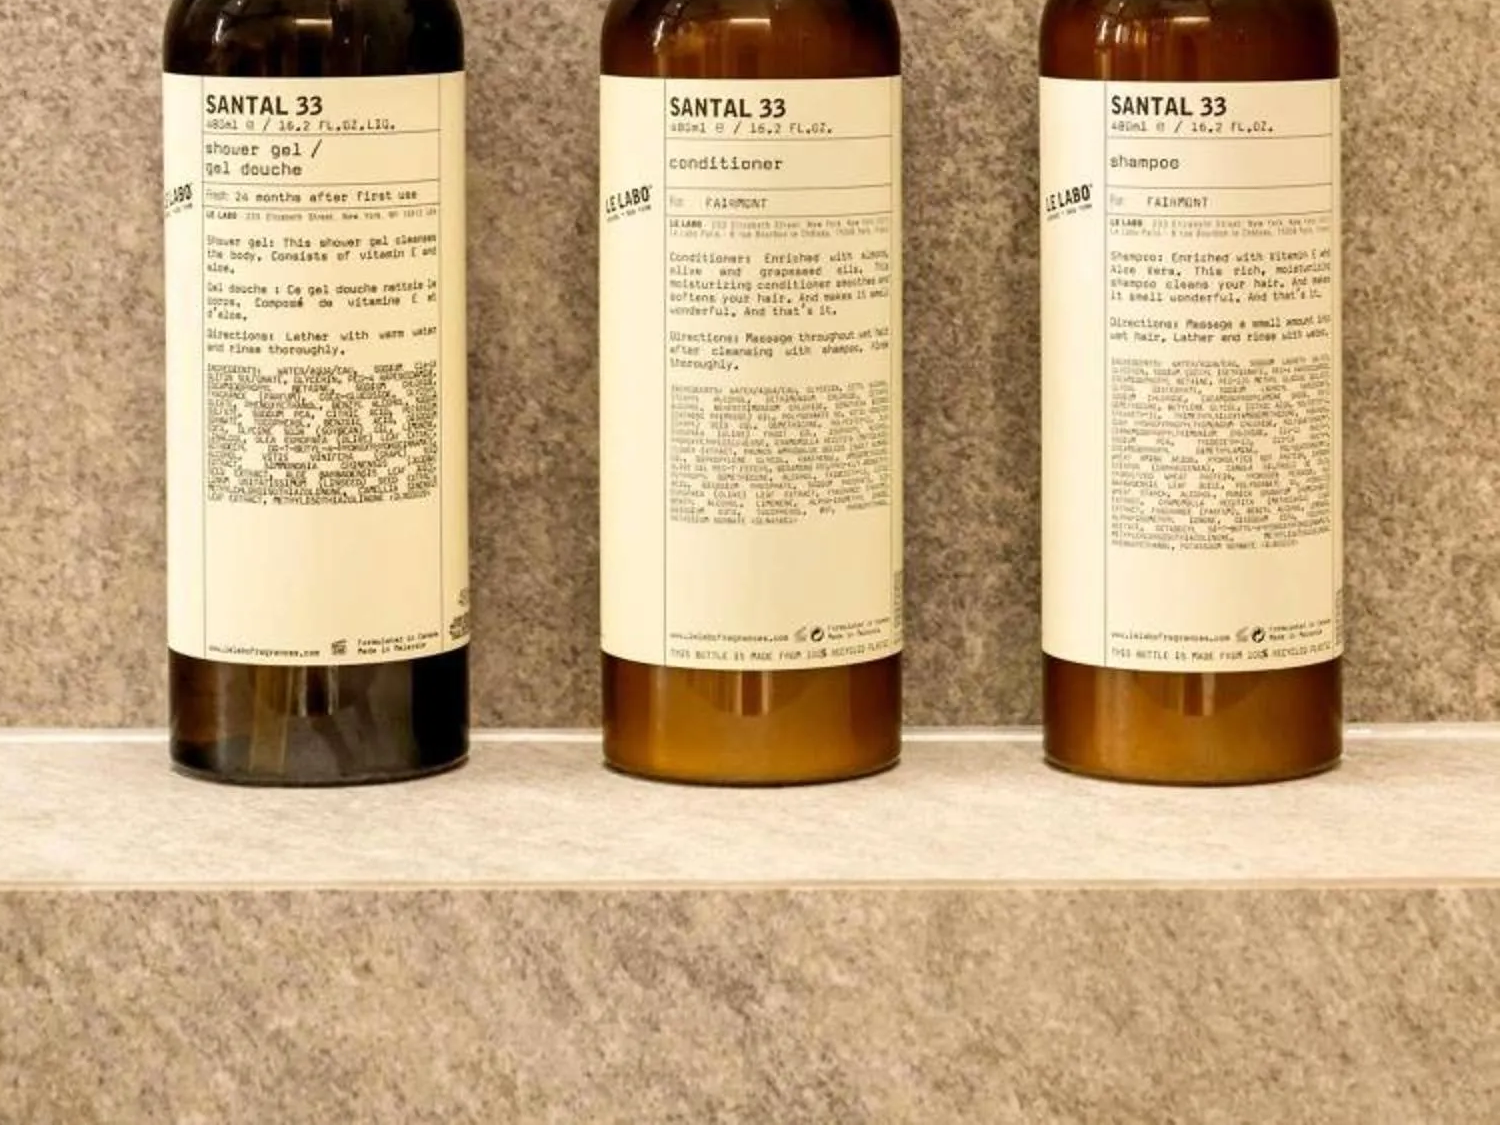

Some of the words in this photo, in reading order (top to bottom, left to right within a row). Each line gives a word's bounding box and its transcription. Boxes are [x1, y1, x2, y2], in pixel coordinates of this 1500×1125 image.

[206, 95, 289, 116] SANTAL
[296, 96, 323, 116] 33
[670, 96, 753, 118] SANTAL
[759, 98, 786, 119] 33
[1111, 95, 1194, 117] SANTAL
[1200, 97, 1227, 117] 33
[279, 120, 311, 132] 16.2
[750, 123, 782, 135] 16.2
[1192, 122, 1223, 134] 16.2
[206, 141, 260, 156] shower
[271, 142, 302, 160] gel
[310, 139, 322, 159] /
[206, 162, 230, 177] gel
[241, 162, 303, 176] douche
[670, 156, 783, 171] conditioner
[1110, 155, 1181, 171] shampoo
[235, 191, 249, 203] 24
[256, 193, 302, 203] months
[309, 191, 348, 203] after
[357, 190, 392, 202] first
[617, 185, 651, 210] LABO
[1057, 184, 1092, 208] LABO
[248, 238, 275, 250] gel:
[284, 237, 311, 248] This
[319, 237, 362, 248] shower
[271, 250, 328, 262] Consists
[336, 250, 351, 262] of
[359, 249, 405, 261] vitamin
[764, 252, 820, 265] Enriched
[1171, 251, 1231, 265] Enriched
[1236, 251, 1265, 264] with
[719, 267, 742, 277] and
[1195, 266, 1223, 277] This
[287, 284, 302, 296] Ce
[308, 284, 329, 297] gel
[336, 283, 378, 295] douche
[756, 279, 832, 291] conditioner
[1166, 279, 1210, 290] cleans
[1218, 280, 1246, 292] your
[1254, 279, 1285, 290] hair.
[348, 295, 401, 308] vitamine
[722, 295, 752, 306] your
[758, 293, 793, 304] hair.
[1130, 291, 1163, 303] smell
[1170, 292, 1241, 304] wonderful.
[1248, 292, 1267, 302] And
[744, 306, 766, 317] And
[773, 303, 813, 316] that's
[1186, 319, 1233, 332] Massage
[1252, 317, 1281, 329] small
[340, 331, 369, 342] with
[746, 333, 794, 346] Massage
[1134, 331, 1167, 344] hair.
[1173, 331, 1216, 343] Lather
[1221, 333, 1241, 343] and
[269, 344, 345, 357] thoroughly.
[712, 346, 773, 359] cleansing
[785, 346, 812, 357] with
